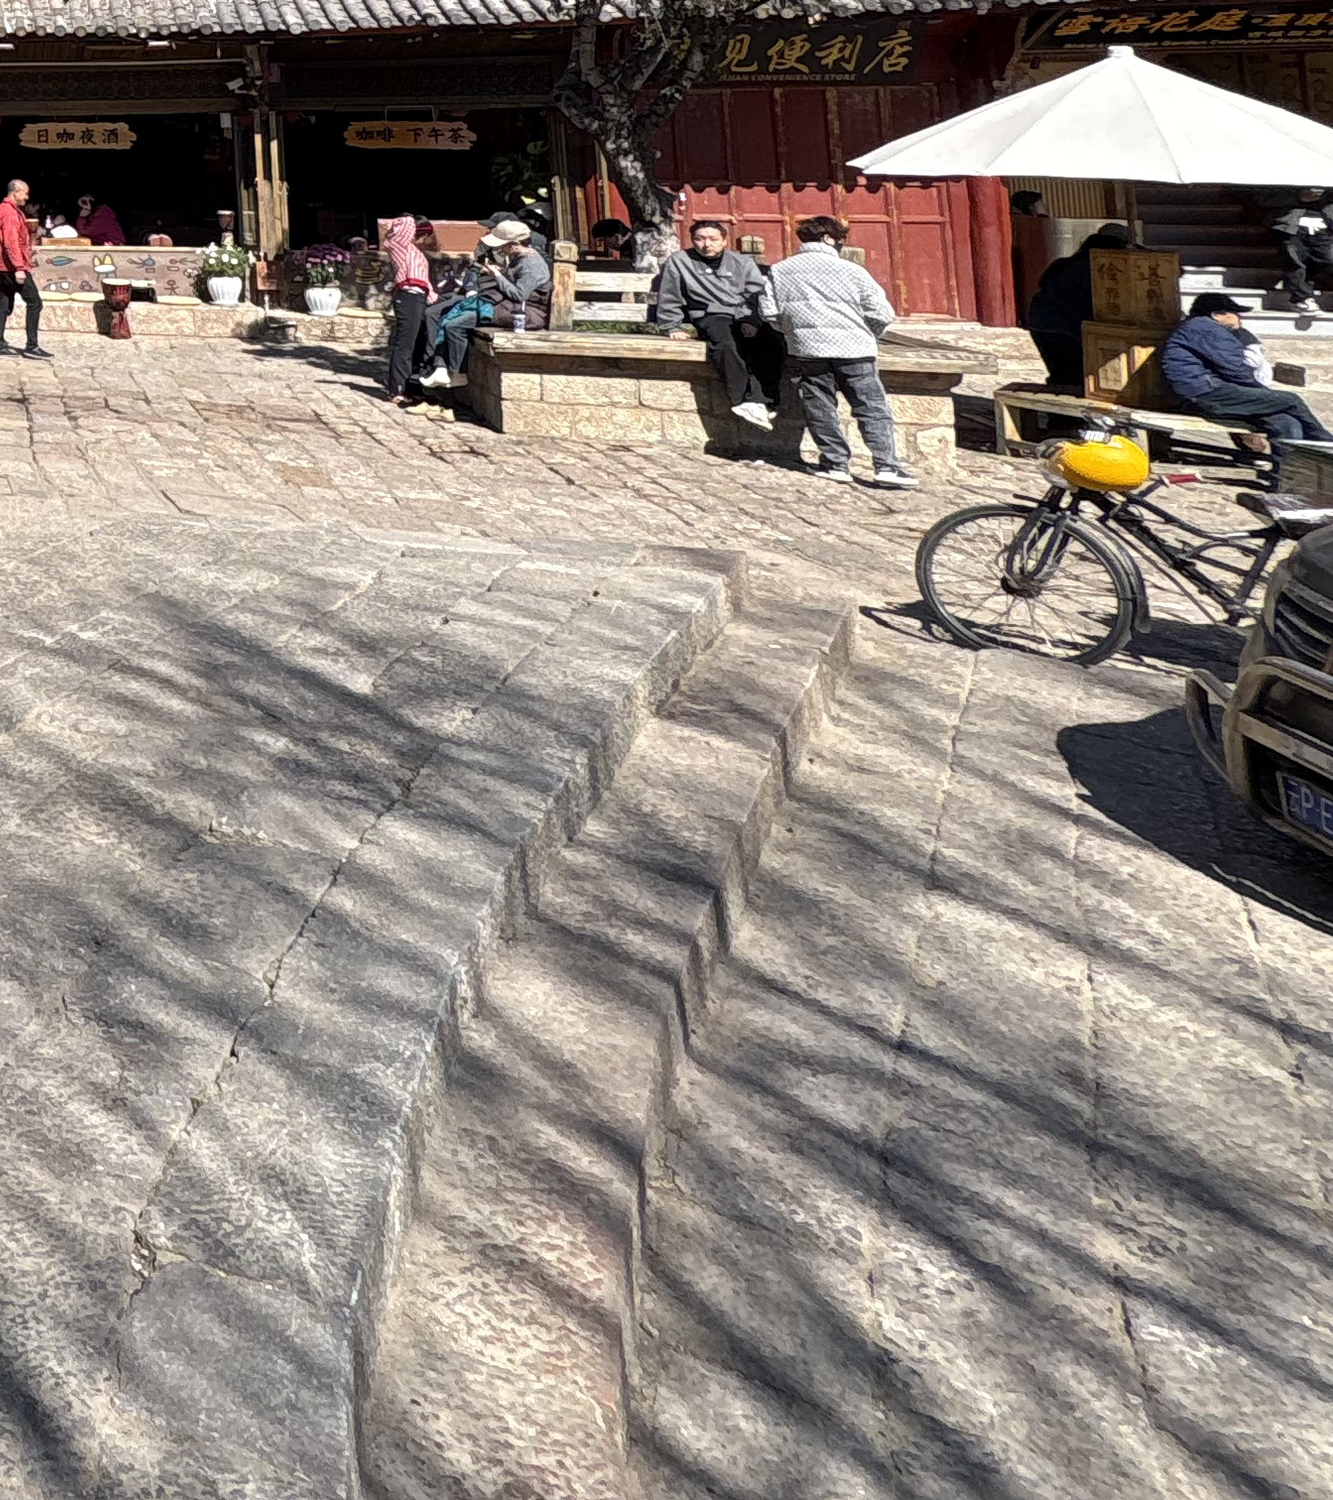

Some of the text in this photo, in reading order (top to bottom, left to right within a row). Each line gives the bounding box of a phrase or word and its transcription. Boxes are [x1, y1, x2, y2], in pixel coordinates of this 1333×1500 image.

[824, 73, 856, 82] STORE
[36, 127, 119, 145] 日咖夜酒
[355, 127, 465, 144] 咖啡 下午茶
